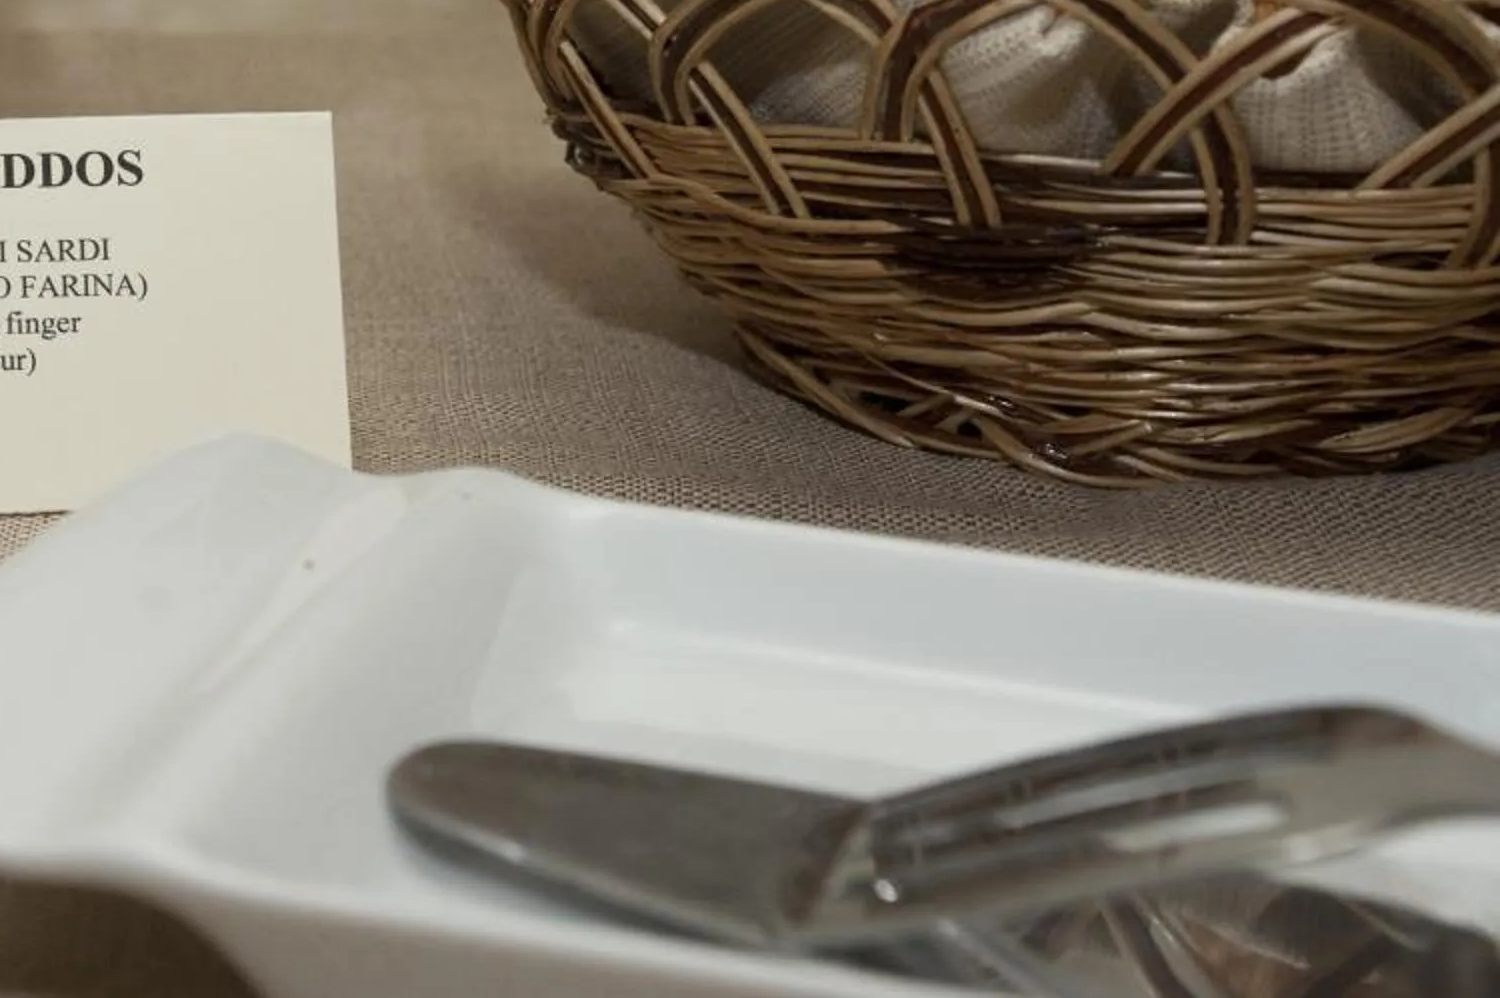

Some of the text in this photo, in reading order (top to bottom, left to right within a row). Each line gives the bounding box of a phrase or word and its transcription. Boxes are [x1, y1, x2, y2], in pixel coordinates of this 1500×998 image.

[16, 237, 110, 263] SARDI
[20, 272, 148, 301] FARINA)
[6, 310, 82, 340] finger
